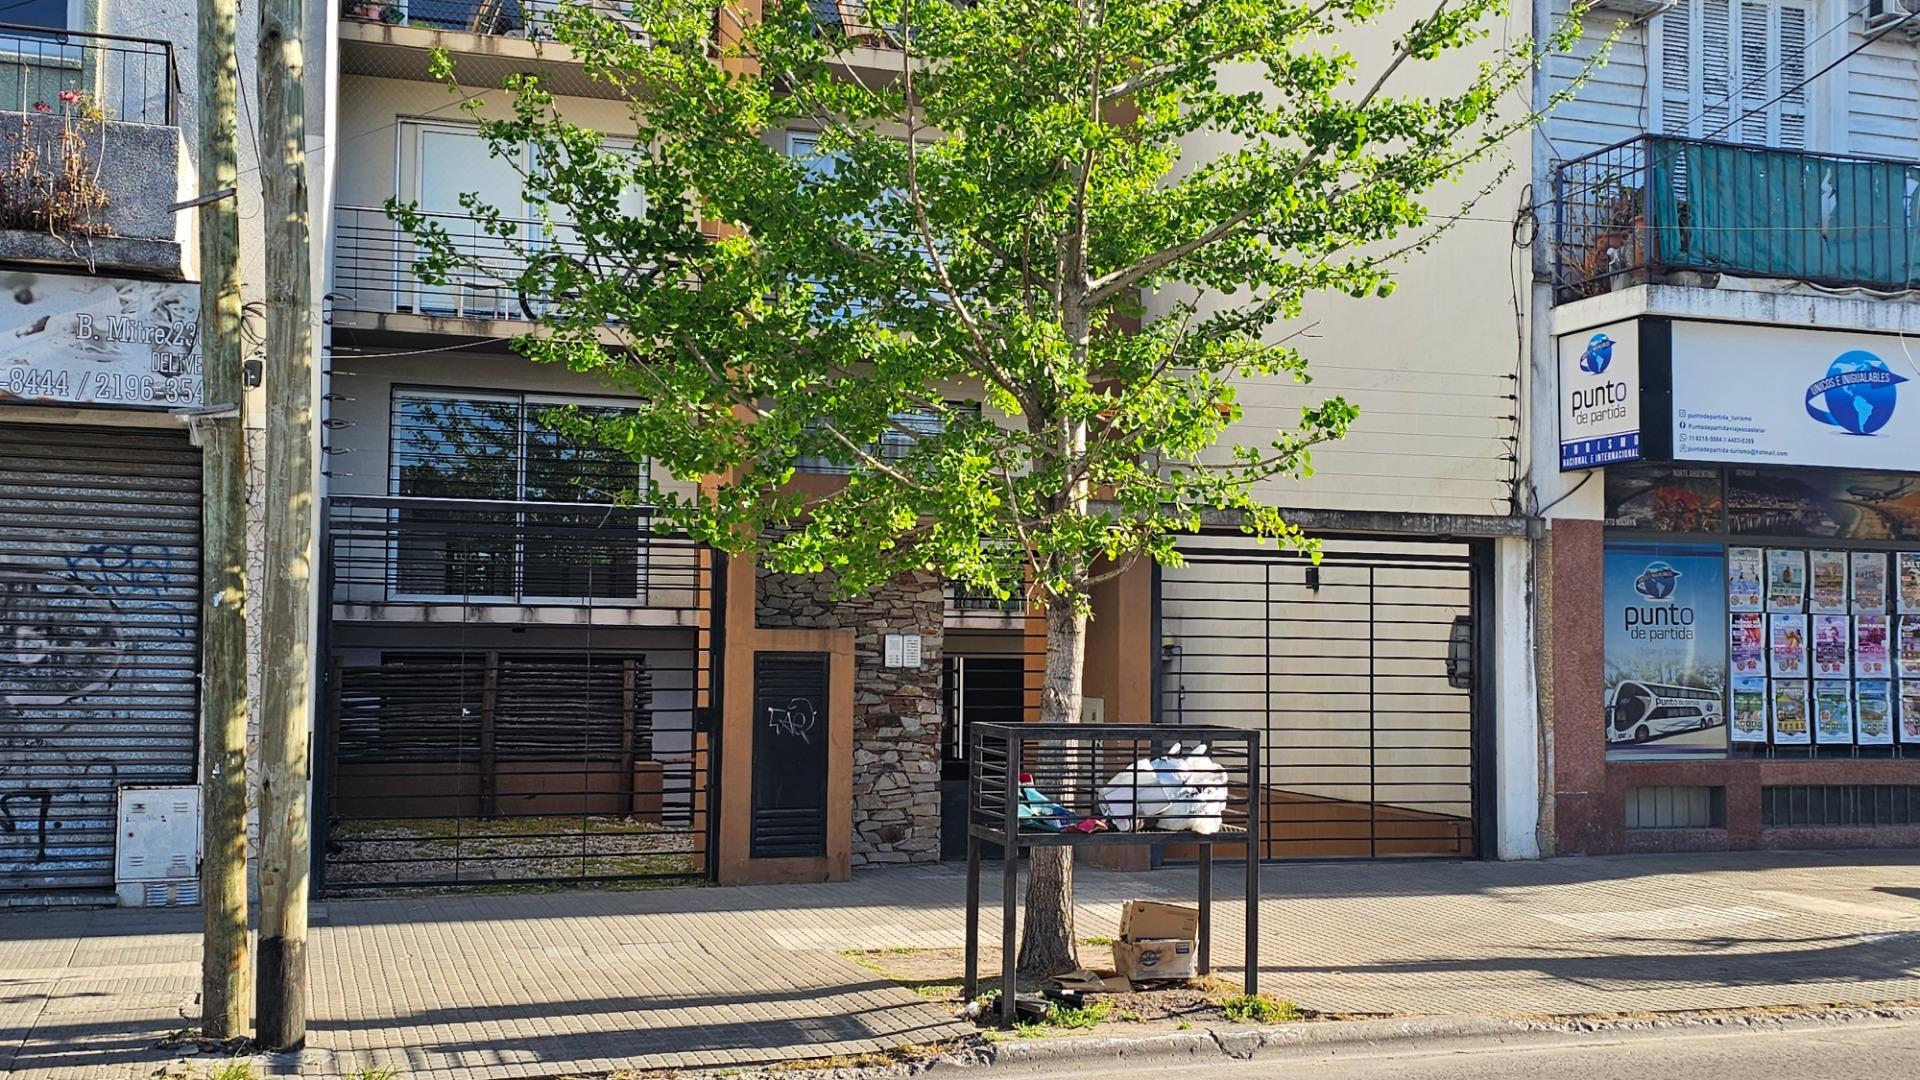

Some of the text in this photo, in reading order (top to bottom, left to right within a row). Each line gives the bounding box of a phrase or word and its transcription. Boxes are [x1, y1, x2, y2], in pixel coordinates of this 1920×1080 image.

[76, 313, 203, 347] B. Mitre 23
[75, 370, 91, 400] /
[1836, 376, 1841, 386] E
[1842, 372, 1891, 384] INIGUALABLES
[1572, 380, 1627, 418] punto
[1576, 404, 1627, 427] de partida
[1562, 434, 1640, 457] TURISMO
[1562, 448, 1640, 468] NACIONAL E INTERNACIONAL
[1625, 603, 1694, 631] punto
[1631, 627, 1694, 643] de partida
